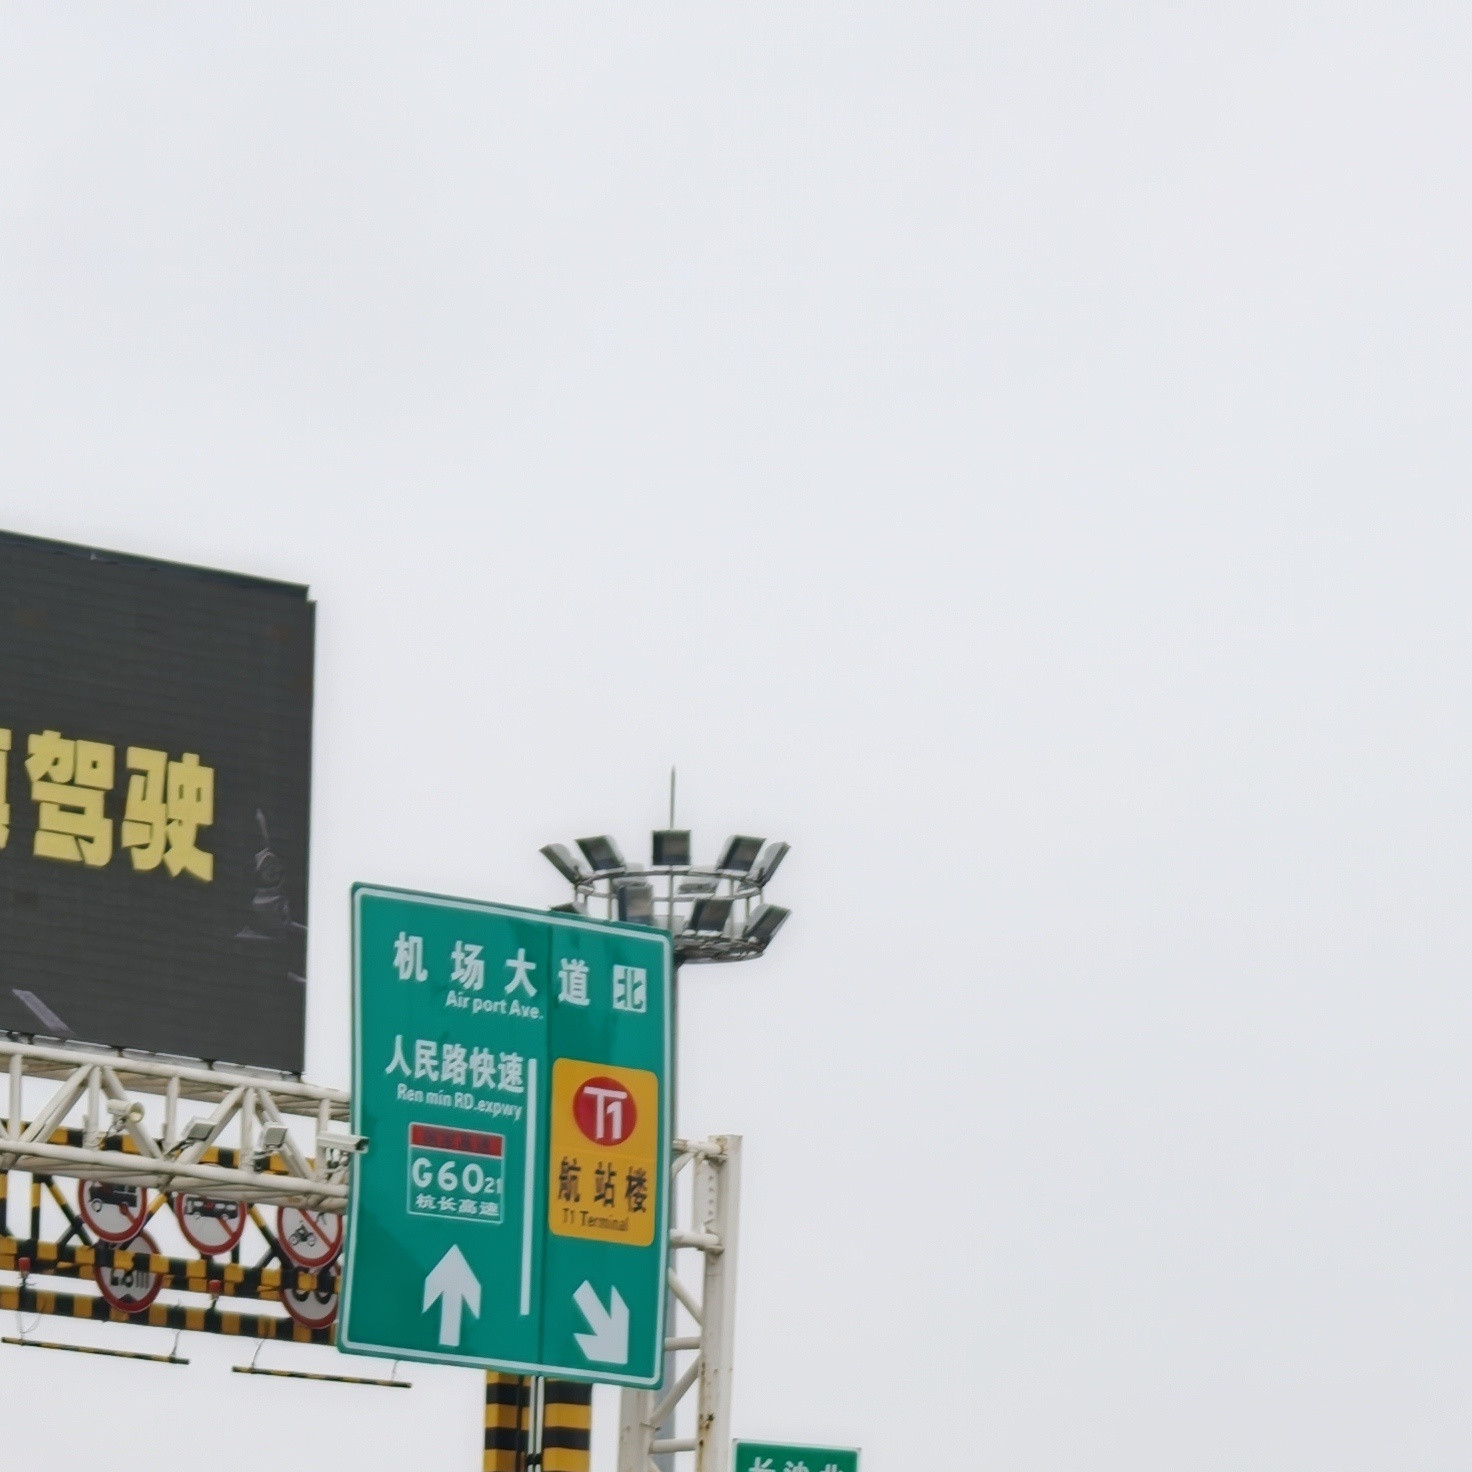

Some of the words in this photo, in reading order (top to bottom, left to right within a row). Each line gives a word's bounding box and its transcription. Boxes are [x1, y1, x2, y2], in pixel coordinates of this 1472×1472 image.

[445, 990, 469, 1009] Air
[472, 998, 506, 1015] port
[385, 1034, 524, 1093] 人民路快速
[583, 1086, 628, 1140] T1
[558, 1156, 647, 1214] 航站楼
